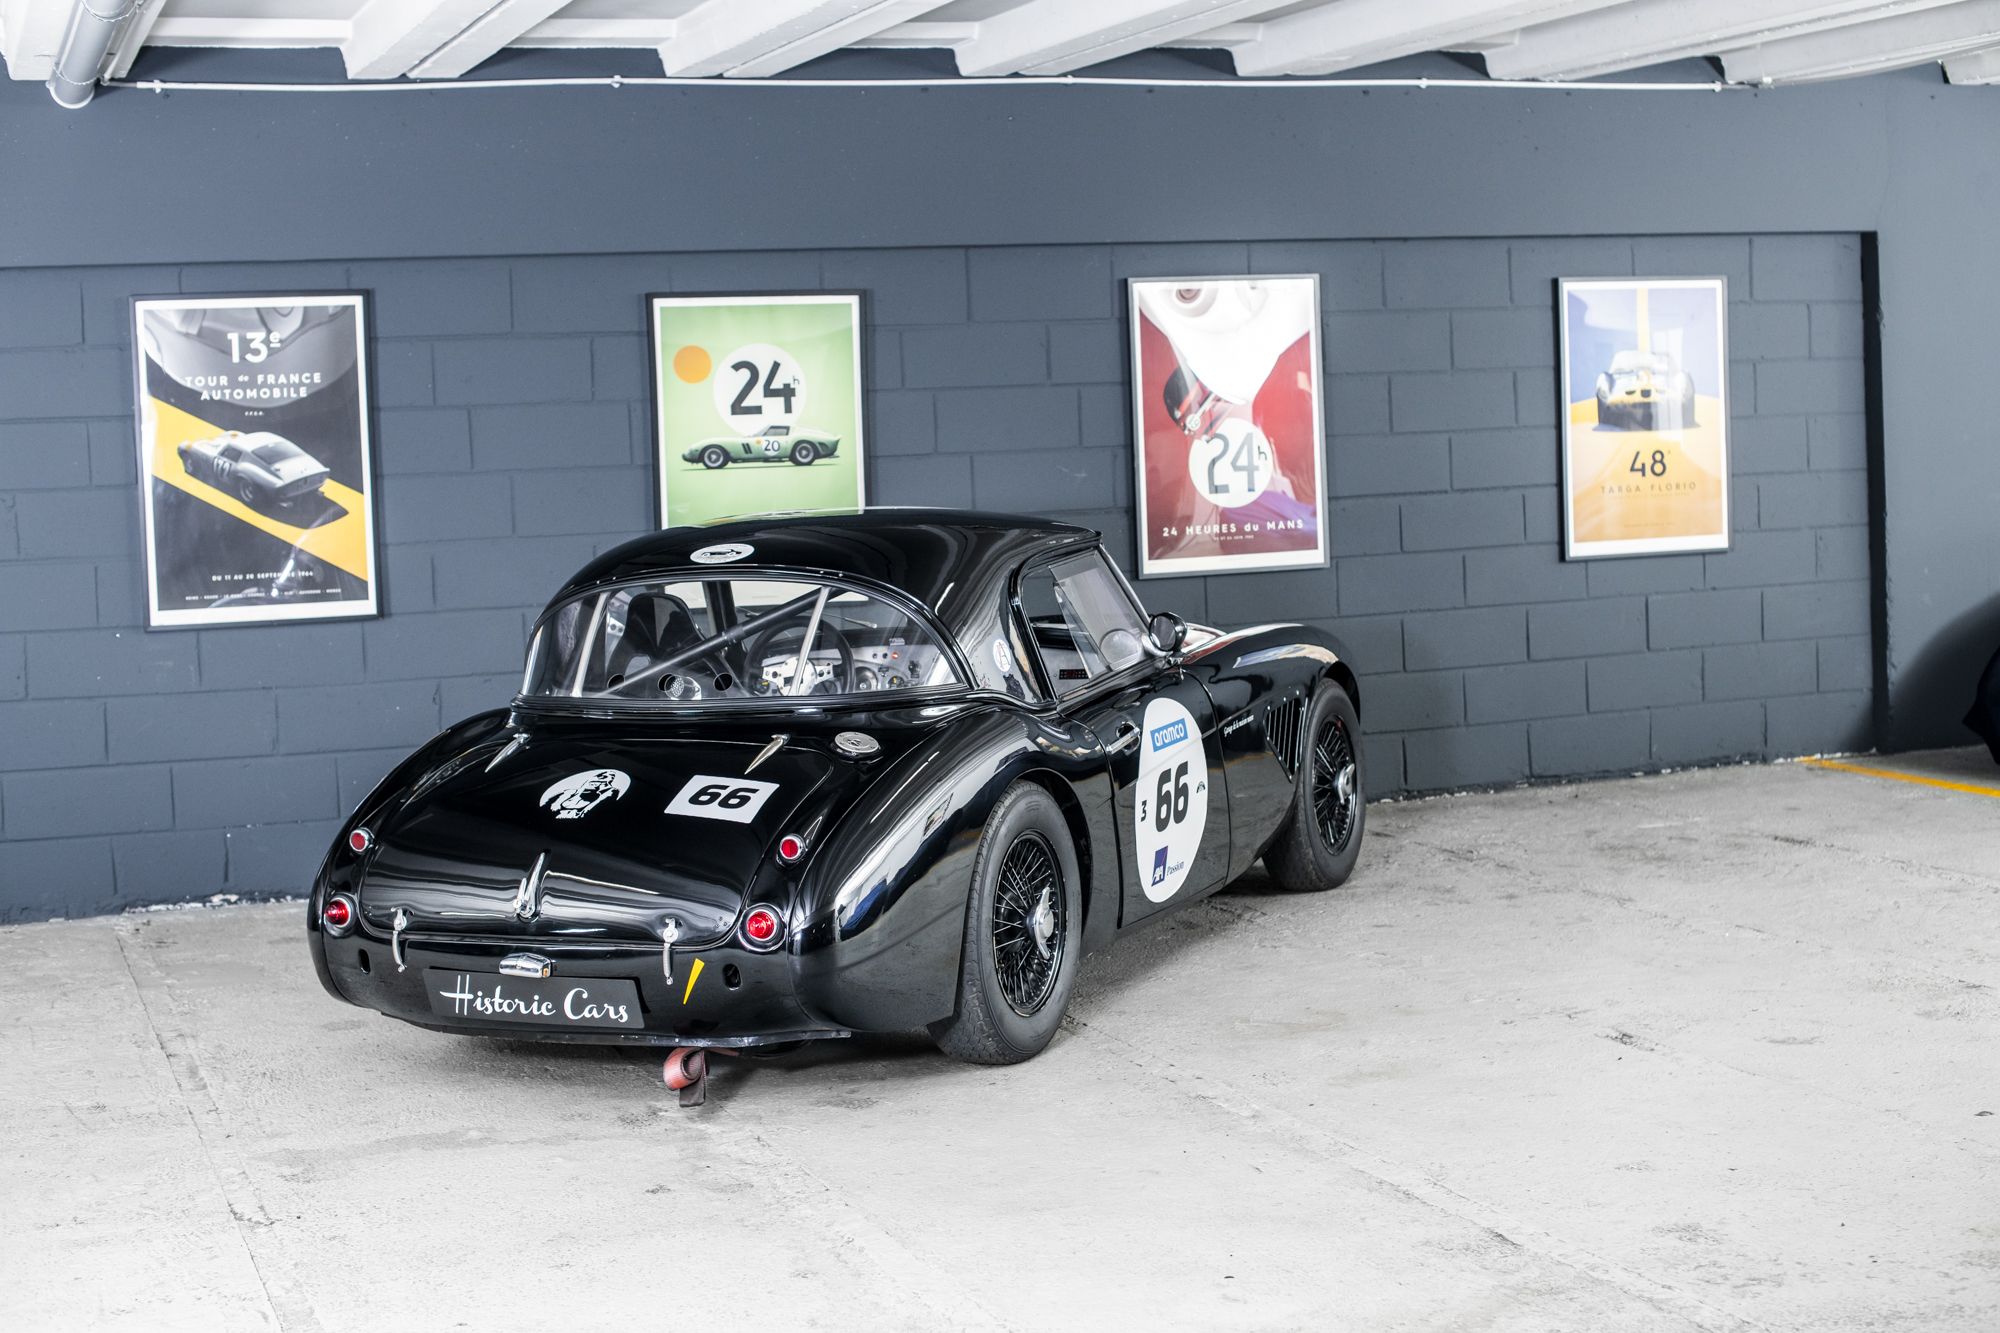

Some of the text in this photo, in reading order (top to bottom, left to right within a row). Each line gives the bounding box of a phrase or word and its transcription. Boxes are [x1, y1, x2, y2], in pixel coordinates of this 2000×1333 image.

[185, 372, 322, 387] TOUR de FRANCE
[200, 387, 308, 400] AUTOMOBILE
[764, 440, 780, 452] 20
[1600, 481, 1696, 494] TARGA FLORIO
[1162, 519, 1304, 537] 24 HEURES du MANS
[1153, 723, 1185, 747] aramco
[688, 784, 759, 810] 66
[1140, 760, 1189, 833] 3 66
[440, 973, 629, 1023] Historic Cars
